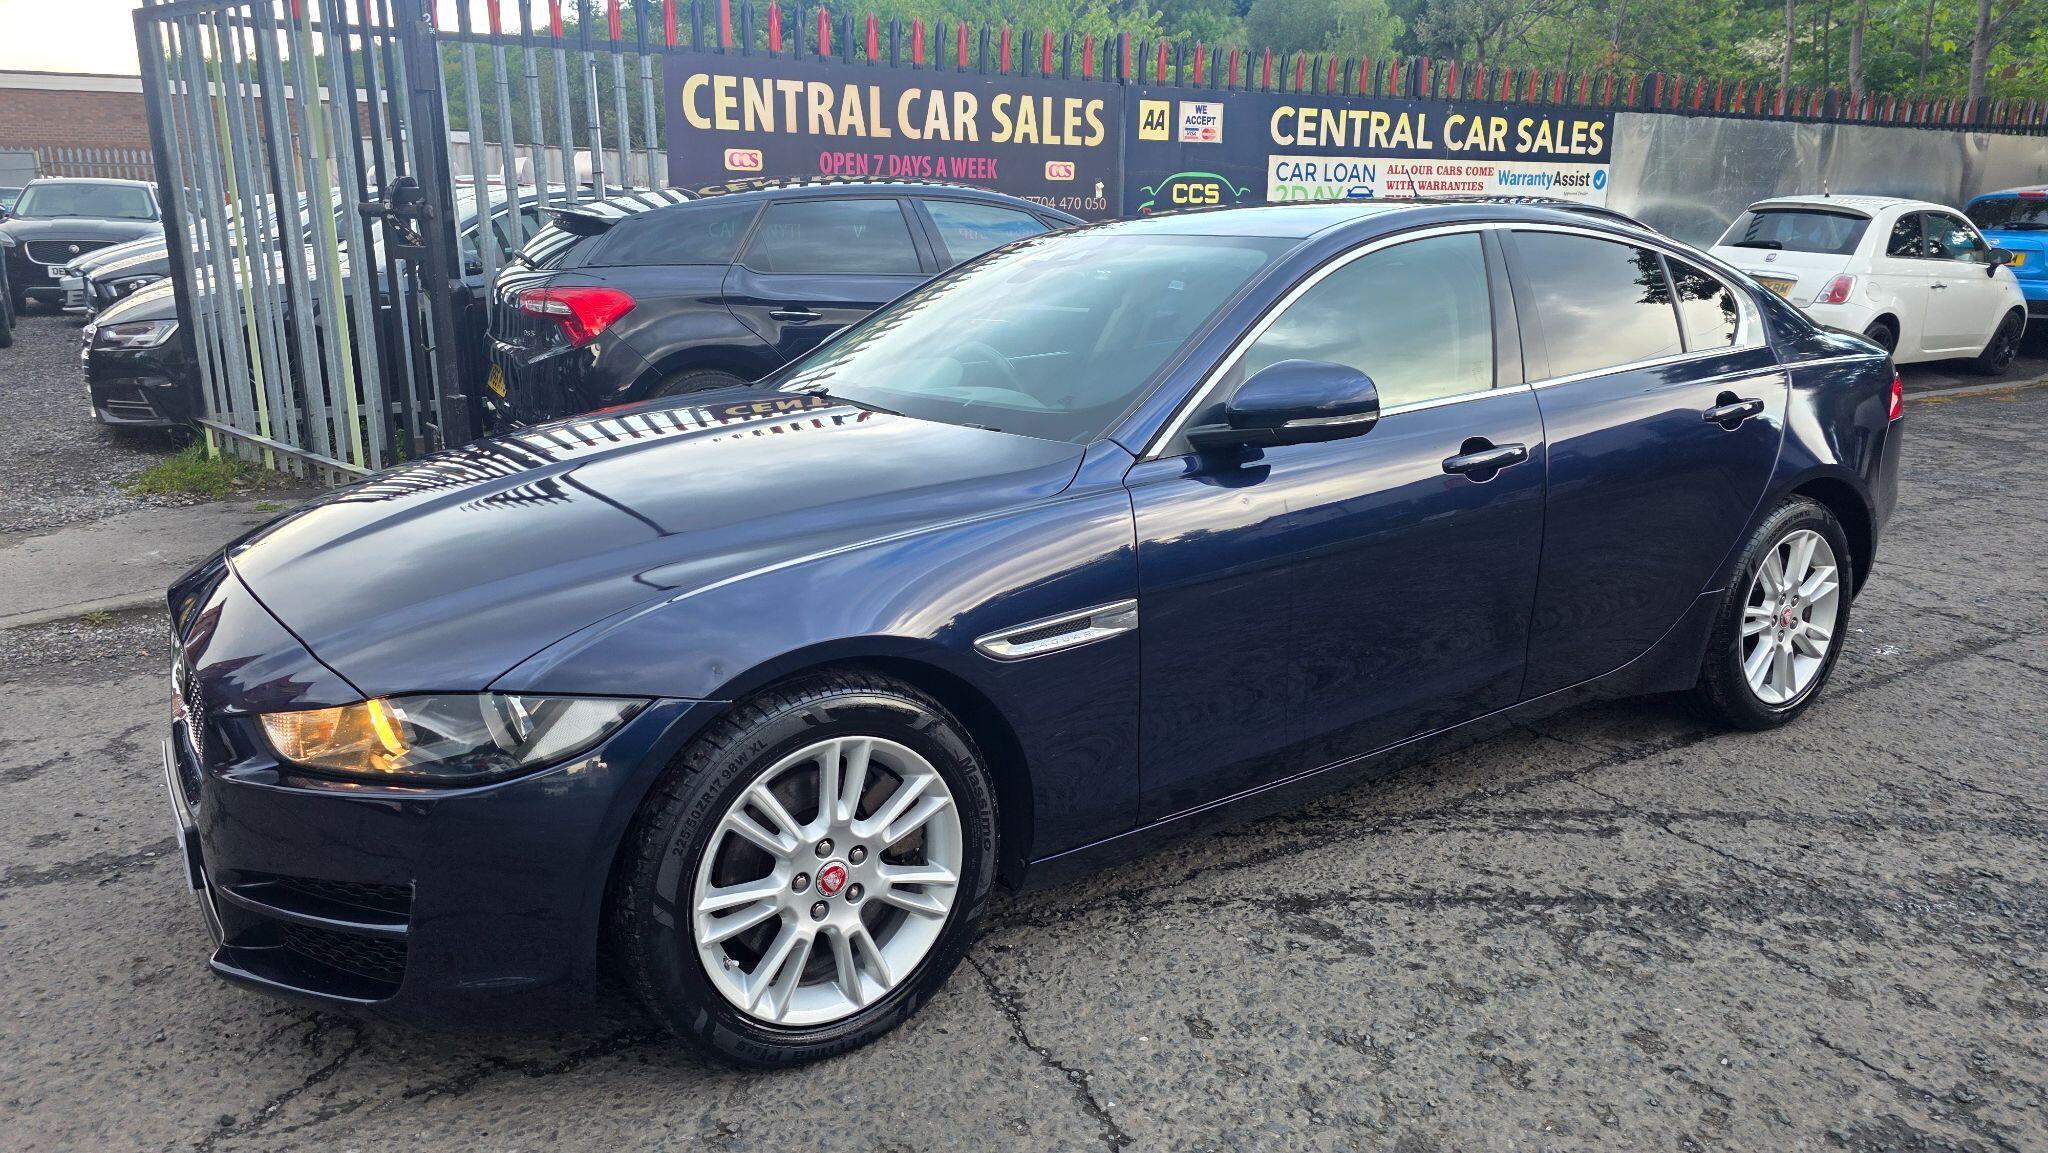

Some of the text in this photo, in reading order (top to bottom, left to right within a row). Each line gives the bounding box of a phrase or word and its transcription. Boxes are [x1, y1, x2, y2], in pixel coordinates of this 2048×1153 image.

[682, 73, 1105, 147] CENTRAL CAR SALES
[1195, 104, 1208, 115] WE
[1142, 109, 1166, 131] AA
[1185, 115, 1217, 126] ACCEPT
[1270, 105, 1606, 156] CENTRAL CAR SALES
[728, 152, 759, 168] CCS
[819, 151, 998, 180] OPEN 7 DAYS A WEEK
[1048, 163, 1072, 178] CCS
[1275, 161, 1376, 183] CAR LOAN
[1387, 164, 1495, 177] ALL OUR CARS COME
[1172, 183, 1221, 204] CCS
[1386, 180, 1485, 192] WITH WARRANTIES
[1060, 196, 1082, 210] 470
[1084, 197, 1107, 210] 050
[1029, 631, 1095, 650] JAGUAR
[748, 739, 768, 757] XL
